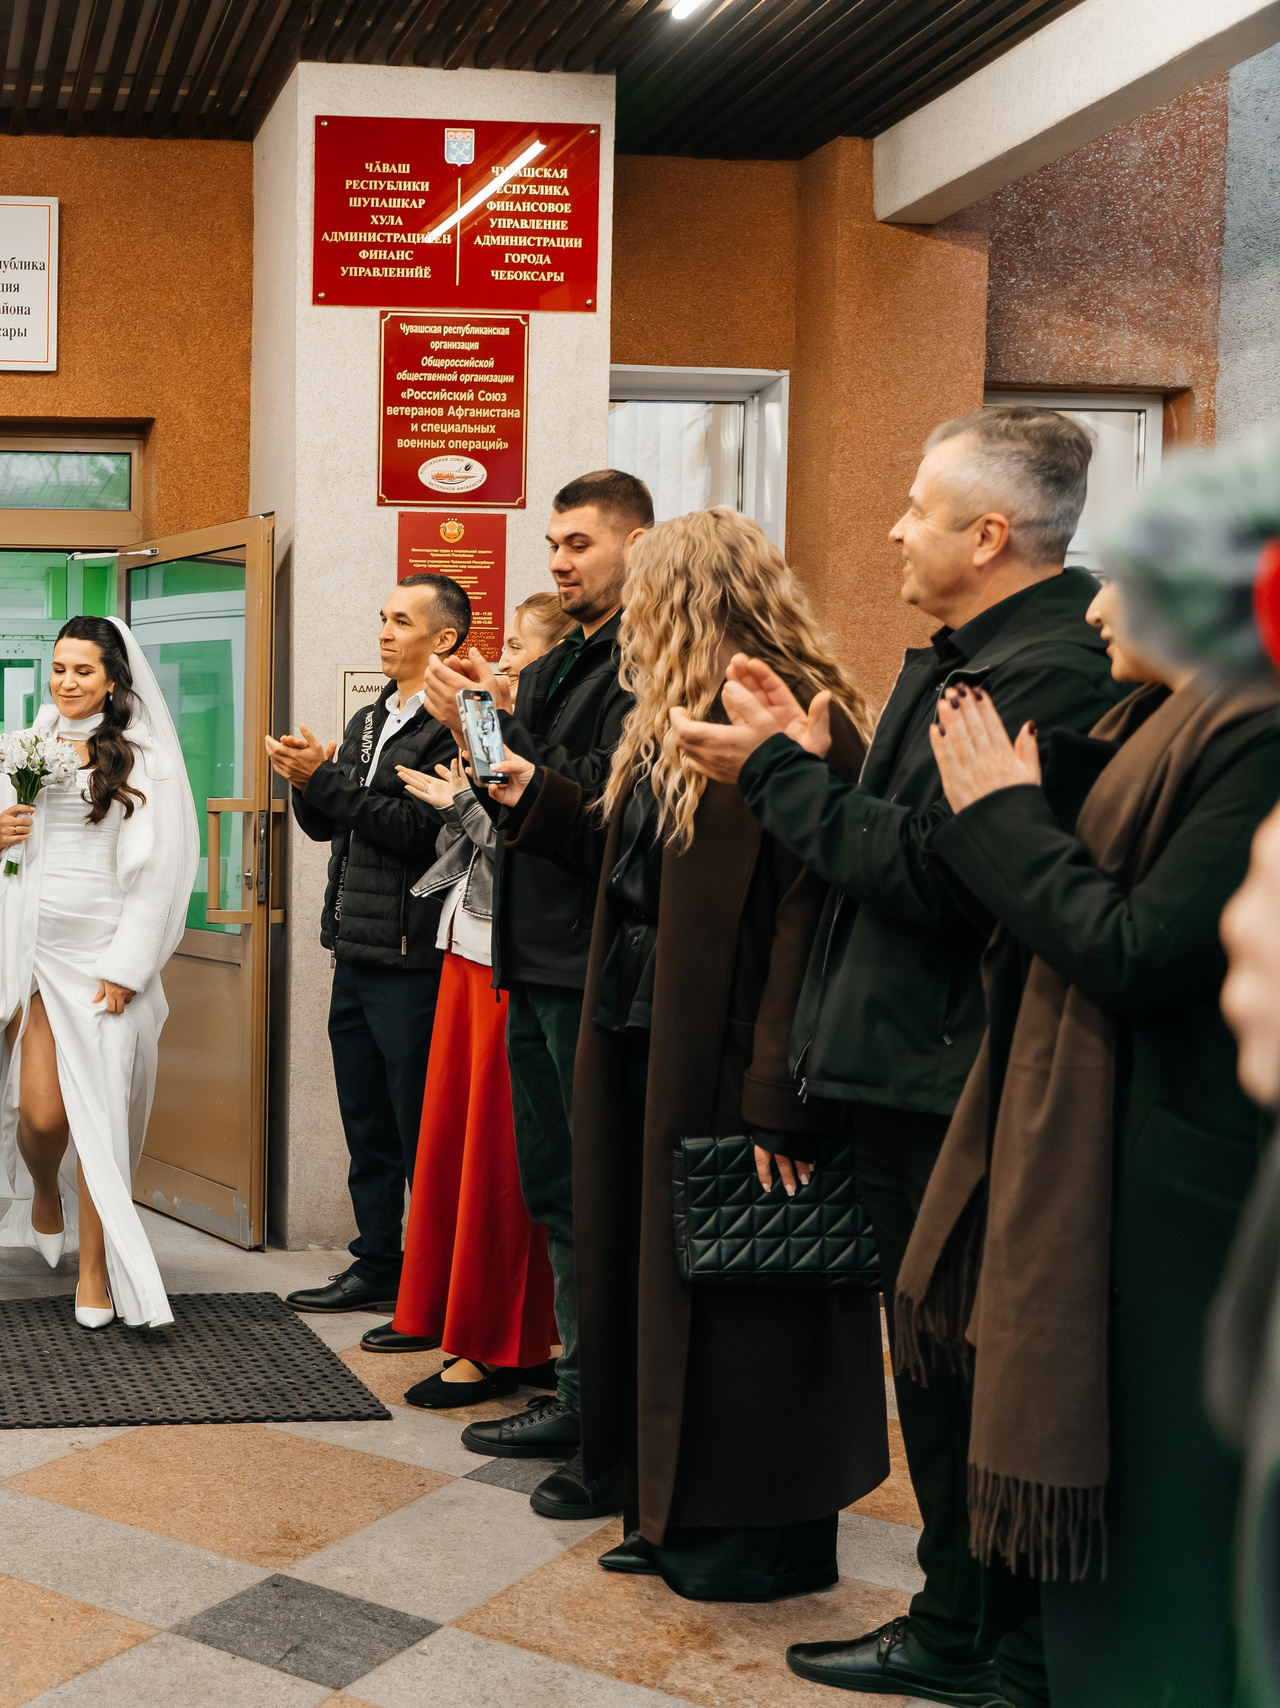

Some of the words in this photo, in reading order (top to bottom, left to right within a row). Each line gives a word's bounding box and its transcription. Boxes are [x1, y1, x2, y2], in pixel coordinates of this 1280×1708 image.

[364, 160, 411, 174] ЧӐВАШ
[345, 179, 430, 192] РЕСПУБЛИКИ
[492, 183, 570, 196] ЕСПУБЛИКА
[349, 197, 426, 209] ШУПАШКАР
[486, 201, 572, 214] ФИНАНСОВОЕ
[370, 214, 403, 226] ХУЛА
[489, 218, 568, 230] УПРАВЛЕНИЕ
[473, 235, 583, 249] АДМИНИСТРАЦИИ
[358, 249, 414, 261] ФИНАНС
[504, 253, 551, 265] ГОРОДА
[490, 270, 565, 282] ЧЕБОКСАРЫ
[400, 322, 442, 337] Чувашская
[443, 323, 510, 337] республиканская
[430, 340, 479, 351] организация
[421, 356, 494, 369] Общероссийской
[396, 370, 458, 382] общественной
[459, 373, 514, 384] организации
[401, 388, 474, 402] «Российский
[477, 390, 507, 402] Союз
[386, 406, 444, 417] ветеранов
[447, 405, 521, 420] Афганистана
[411, 422, 418, 432] и
[420, 422, 496, 434] специальных
[397, 439, 446, 449] военных
[448, 438, 508, 452] операций»
[361, 730, 373, 764] CALVIN
